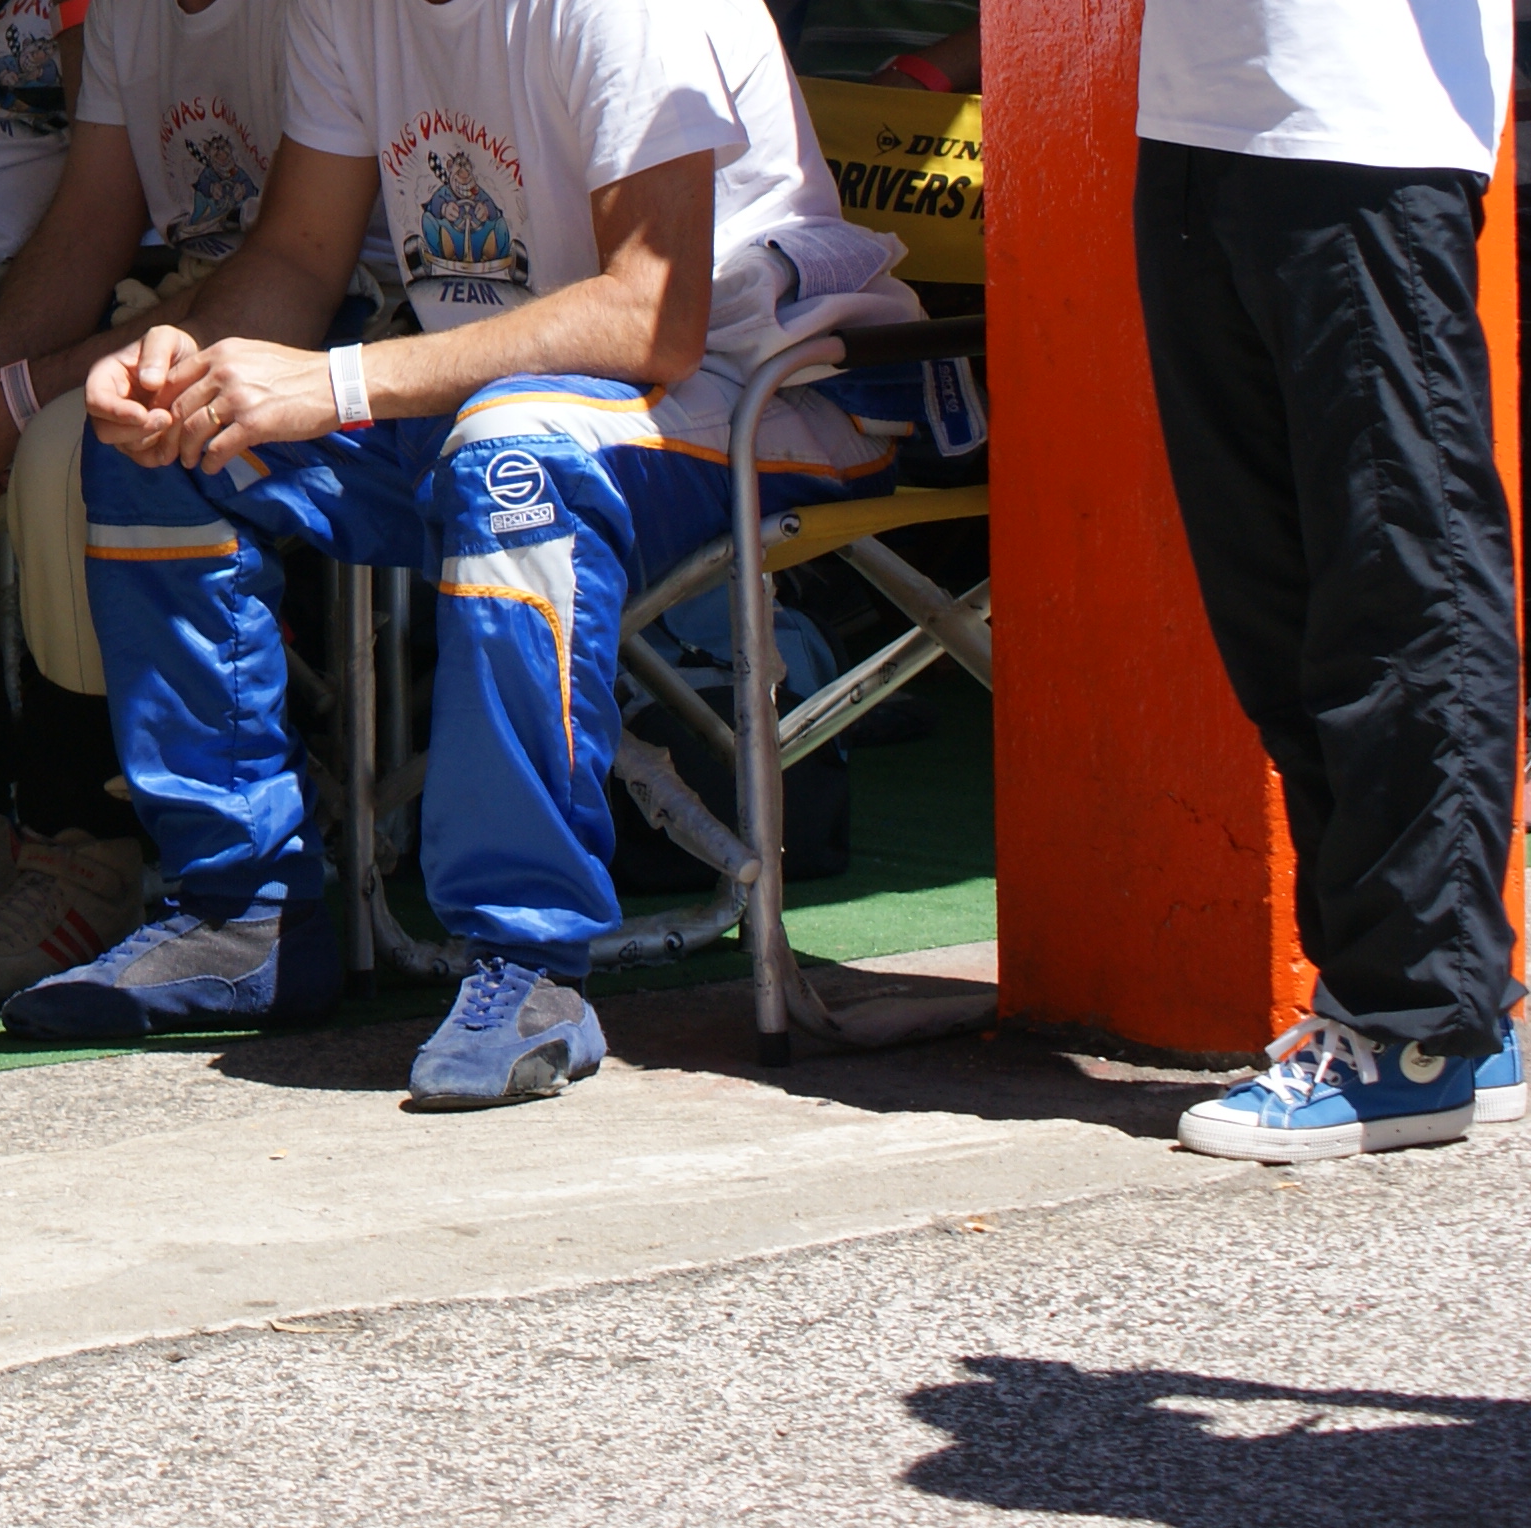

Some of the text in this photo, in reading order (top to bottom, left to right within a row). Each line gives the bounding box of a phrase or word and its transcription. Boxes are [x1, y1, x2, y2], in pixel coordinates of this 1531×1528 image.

[382, 121, 416, 176] PAIS
[905, 135, 985, 162] DUN
[440, 280, 504, 306] TEAM
[492, 506, 551, 531] sparco
